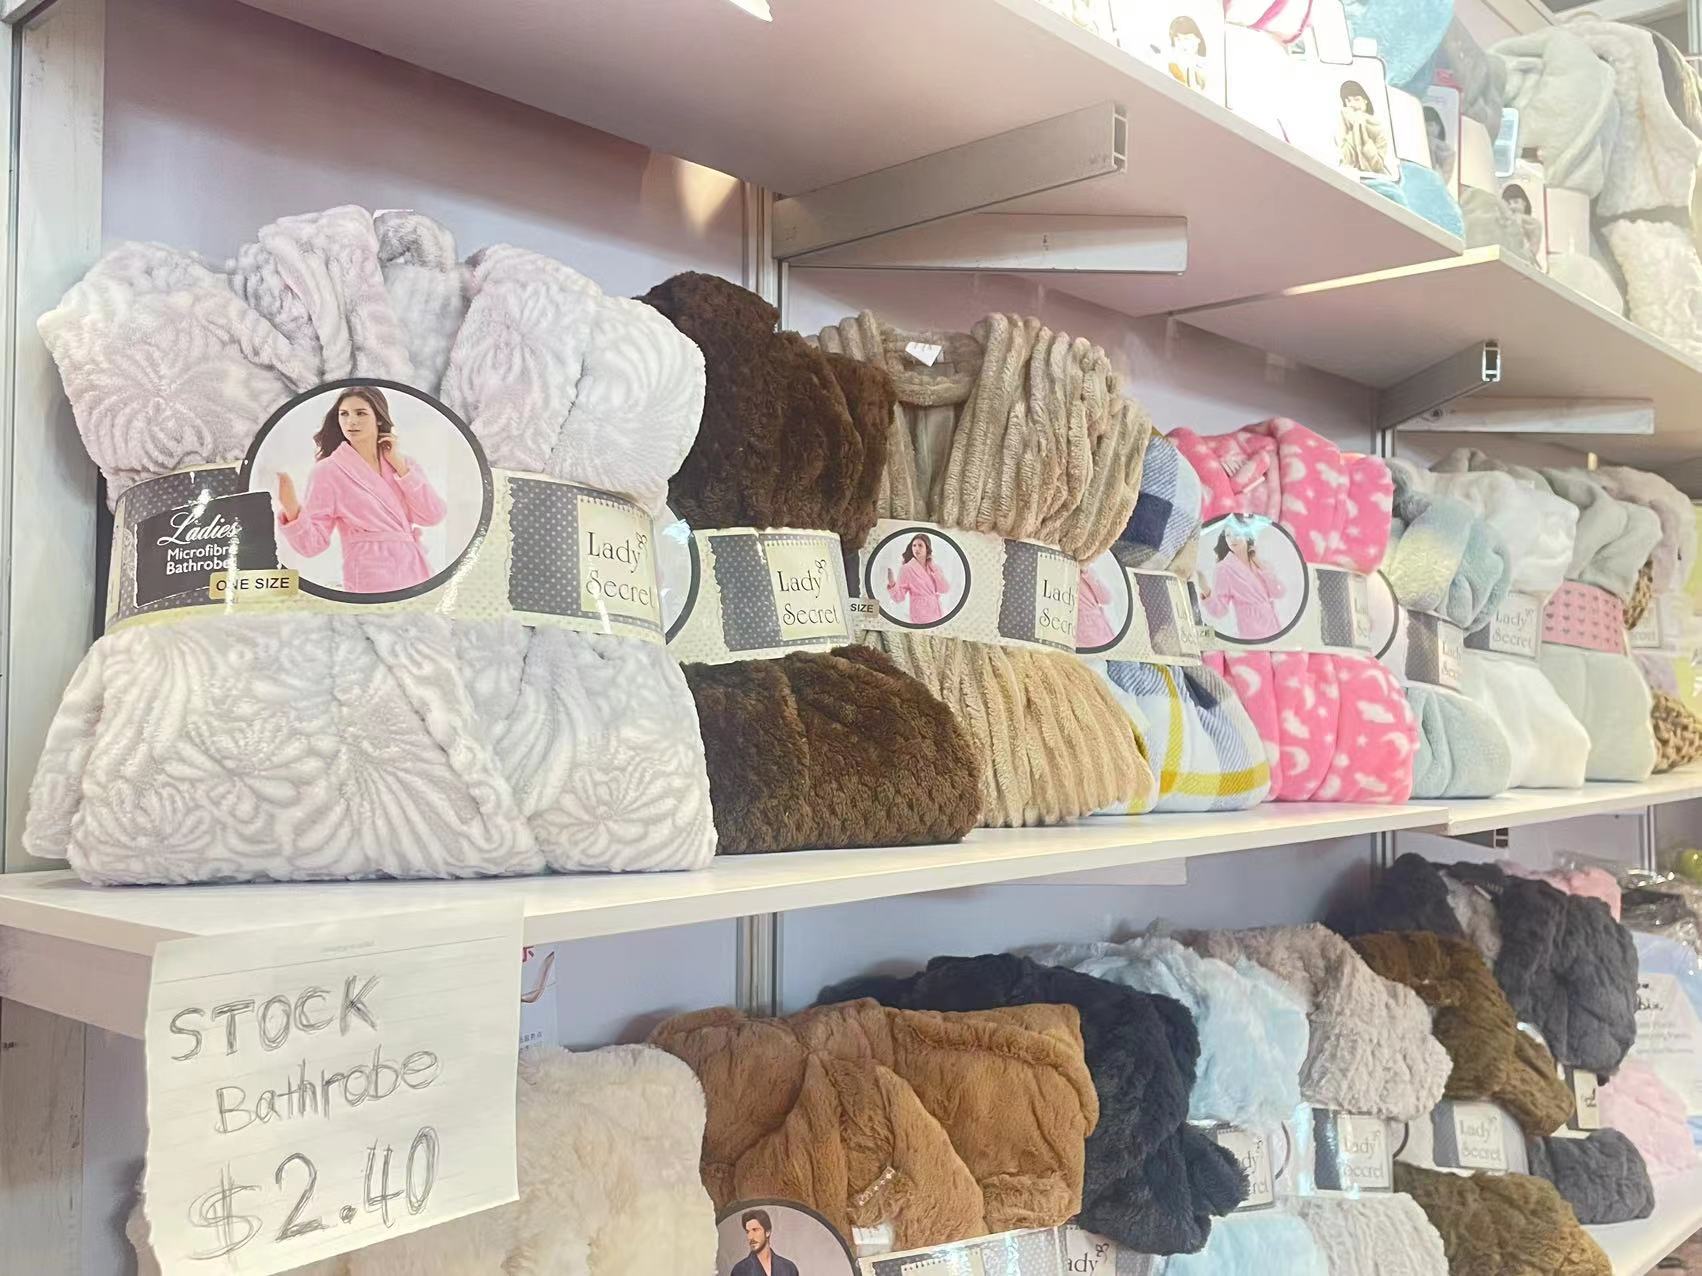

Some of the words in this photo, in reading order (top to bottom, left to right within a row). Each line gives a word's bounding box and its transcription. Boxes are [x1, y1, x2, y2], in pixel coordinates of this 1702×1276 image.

[587, 531, 641, 574] Lady
[255, 577, 290, 590] SIZE
[586, 569, 657, 609] Secret
[777, 570, 822, 599] Lady
[782, 602, 840, 626] Secret
[850, 603, 874, 614] SIZE
[169, 974, 381, 1062] STOCK
[214, 1043, 443, 1135] Bathrobe
[187, 1126, 440, 1268] $2.40
[1067, 1252, 1099, 1276] ady
